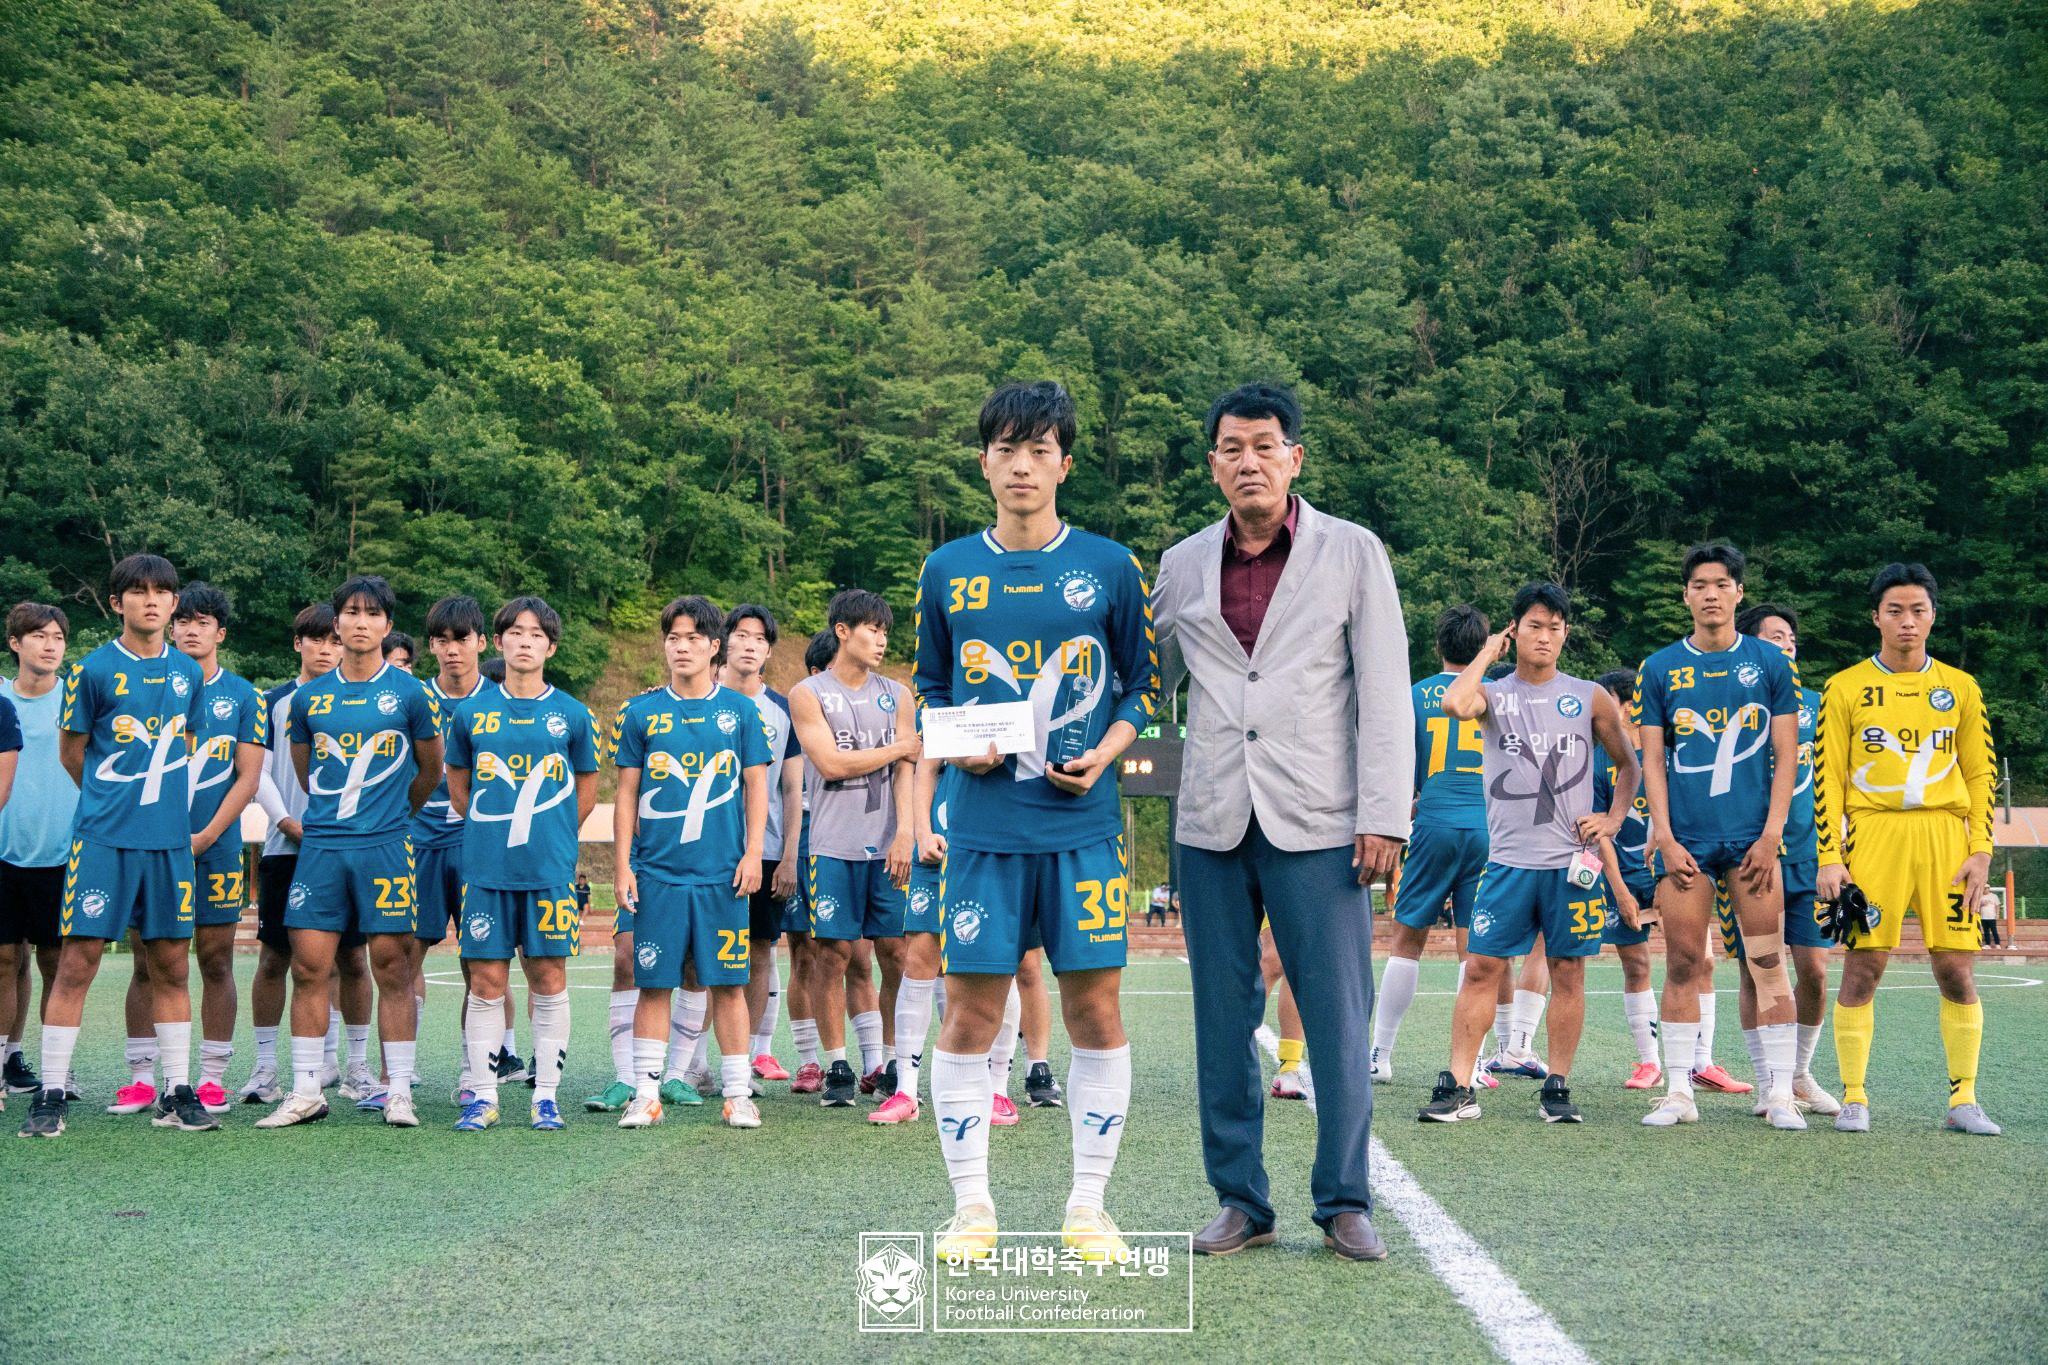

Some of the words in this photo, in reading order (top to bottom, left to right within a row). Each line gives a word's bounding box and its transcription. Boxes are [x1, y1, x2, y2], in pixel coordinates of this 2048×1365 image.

[949, 576, 990, 614] 39
[1003, 583, 1043, 594] hummel
[962, 639, 1092, 685] 용인대
[114, 673, 129, 696] 2
[1668, 666, 1695, 691] 33
[308, 694, 335, 716] 23
[820, 692, 843, 713] 37
[1495, 692, 1520, 716] 24
[1860, 686, 1884, 708] 31
[472, 711, 501, 735] 26
[509, 717, 535, 725] hummel
[647, 713, 674, 736] 25
[1675, 703, 1759, 736] 용인대
[314, 733, 397, 760] 용인대
[1426, 717, 1484, 778] 15
[1503, 732, 1576, 757] 용인대
[1862, 727, 1953, 754] 용인대
[476, 753, 564, 782] 용인대
[178, 881, 193, 913] 2
[207, 872, 242, 902] 32
[373, 876, 411, 909] 23
[537, 899, 572, 932] 26
[1076, 877, 1126, 931] 39
[1568, 898, 1605, 934] 35
[717, 928, 751, 961] 25
[1090, 931, 1123, 943] hummel
